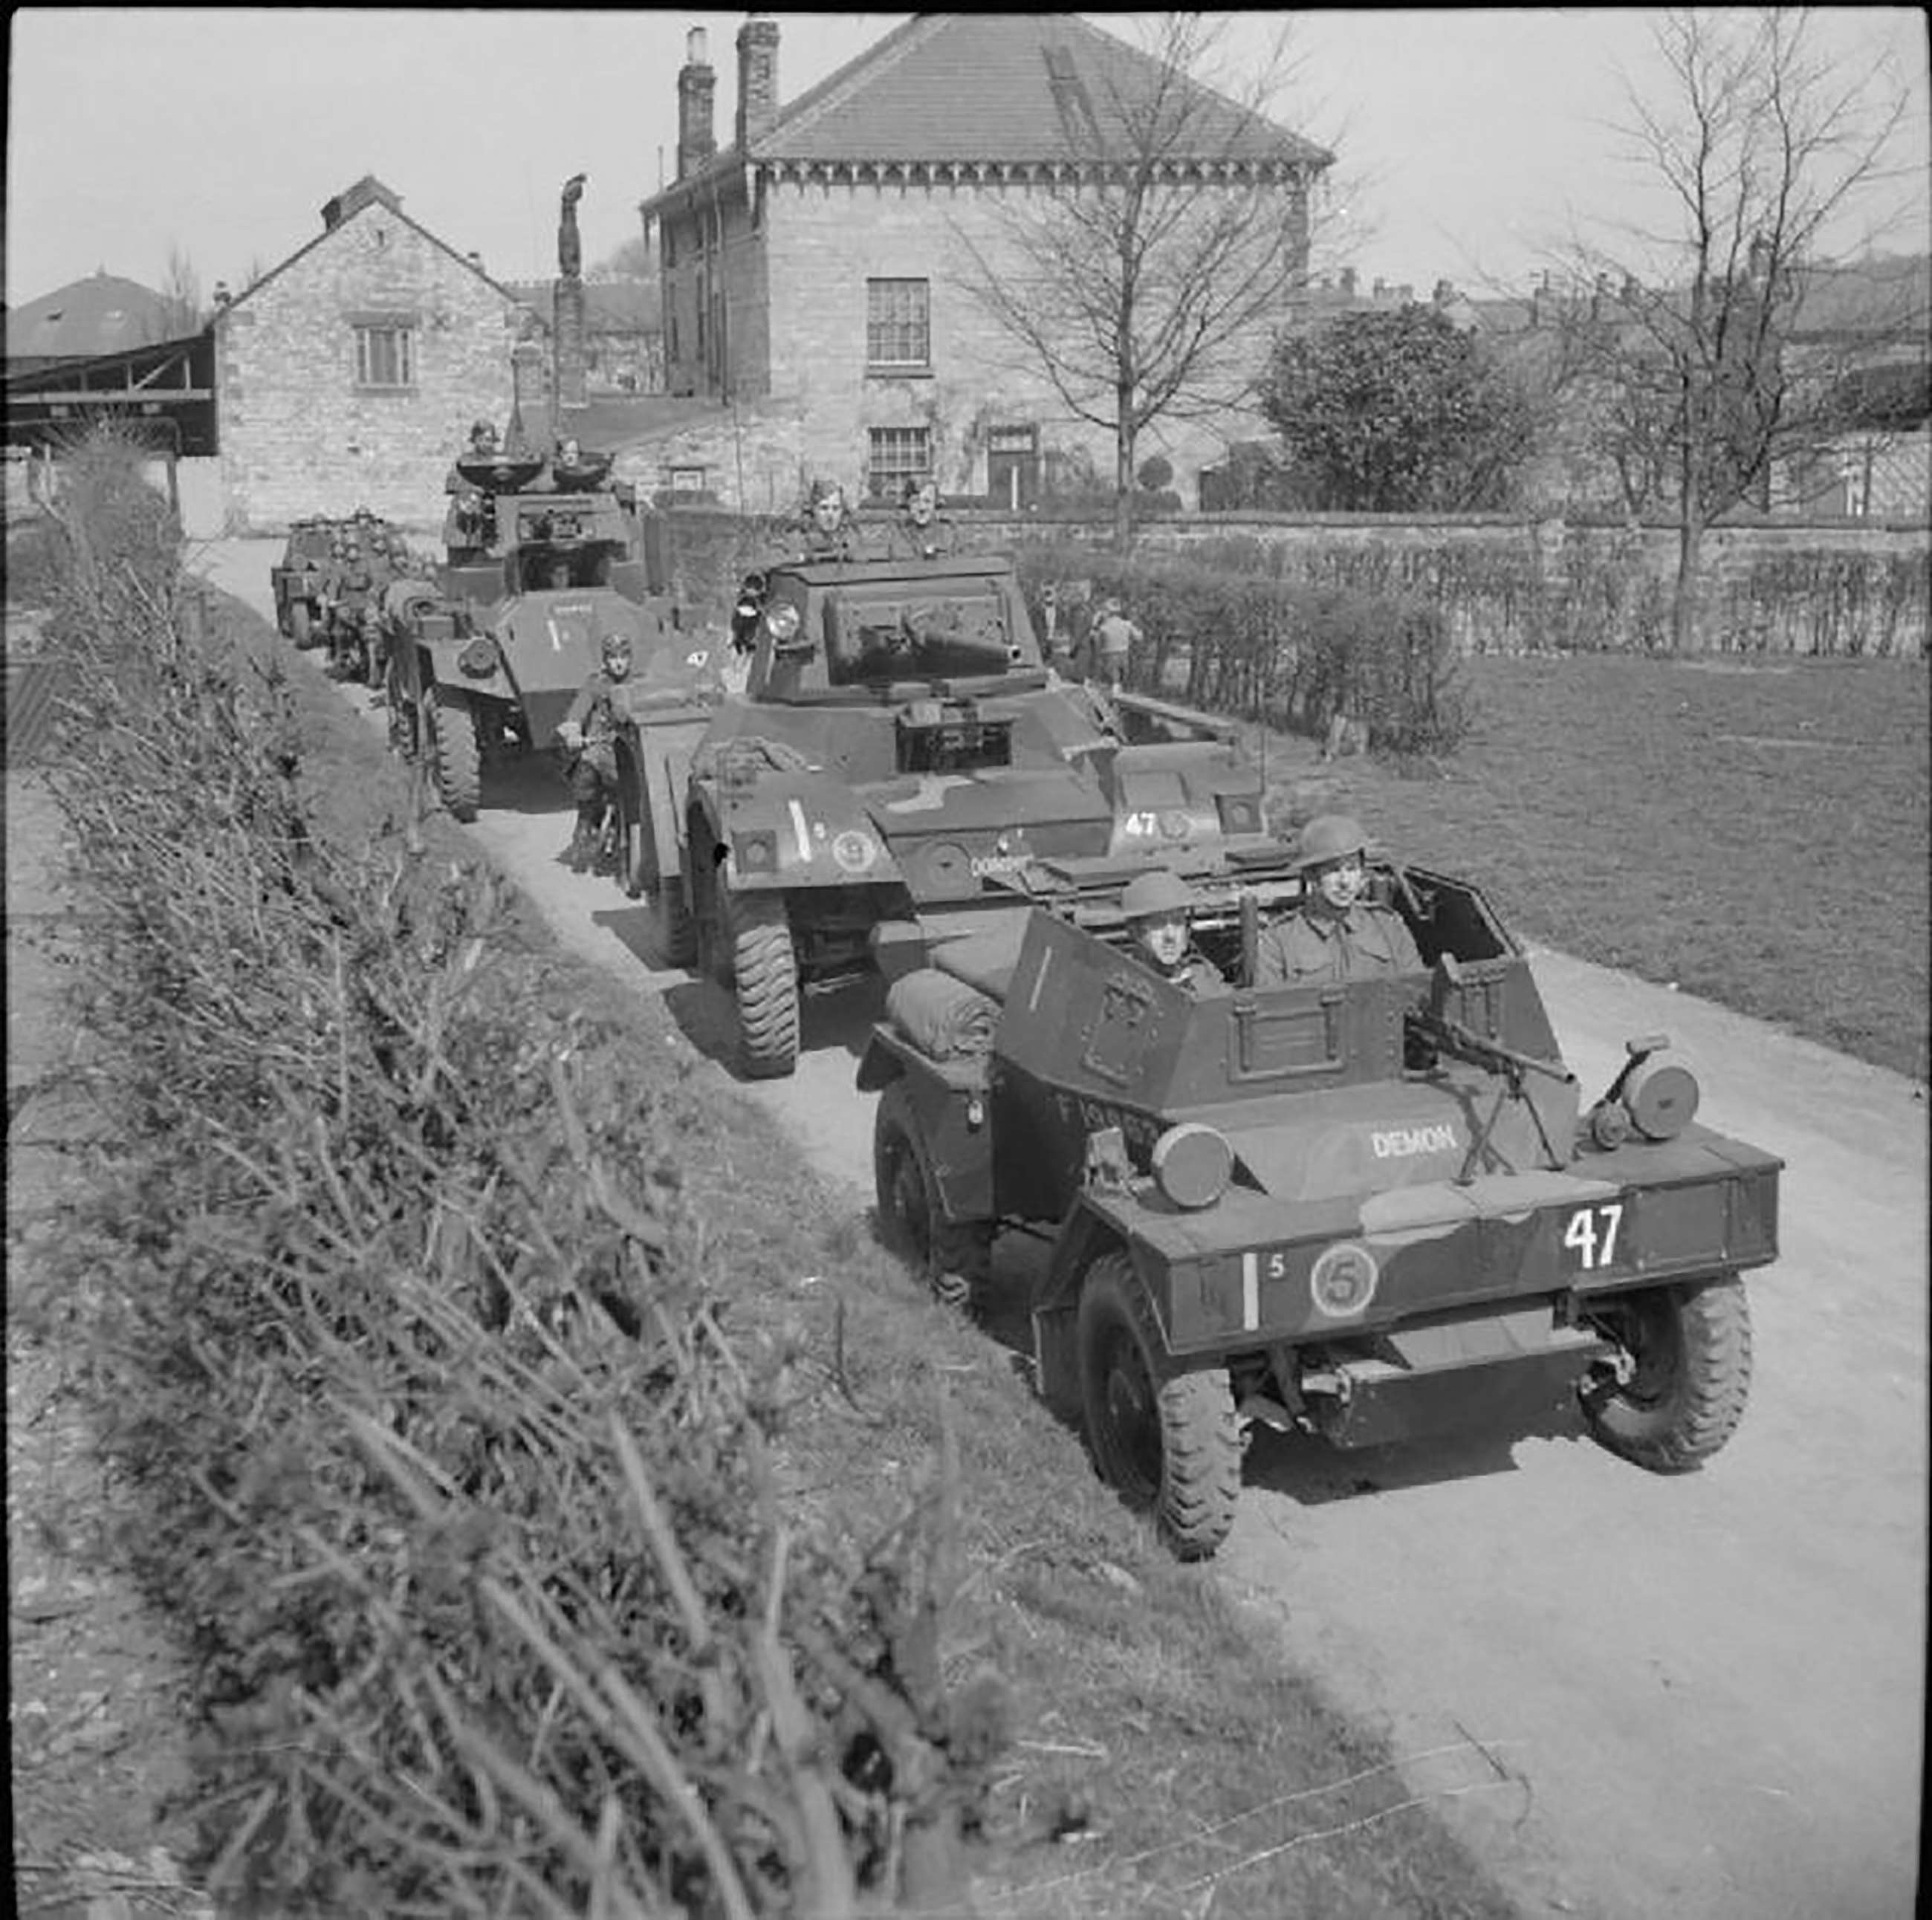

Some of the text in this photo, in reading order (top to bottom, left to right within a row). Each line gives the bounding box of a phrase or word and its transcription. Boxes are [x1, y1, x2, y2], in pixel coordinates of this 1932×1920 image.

[1126, 812, 1155, 837] 47
[1372, 1123, 1458, 1158] DEMON
[1268, 1253, 1285, 1278] 5
[1564, 1204, 1623, 1268] 47
